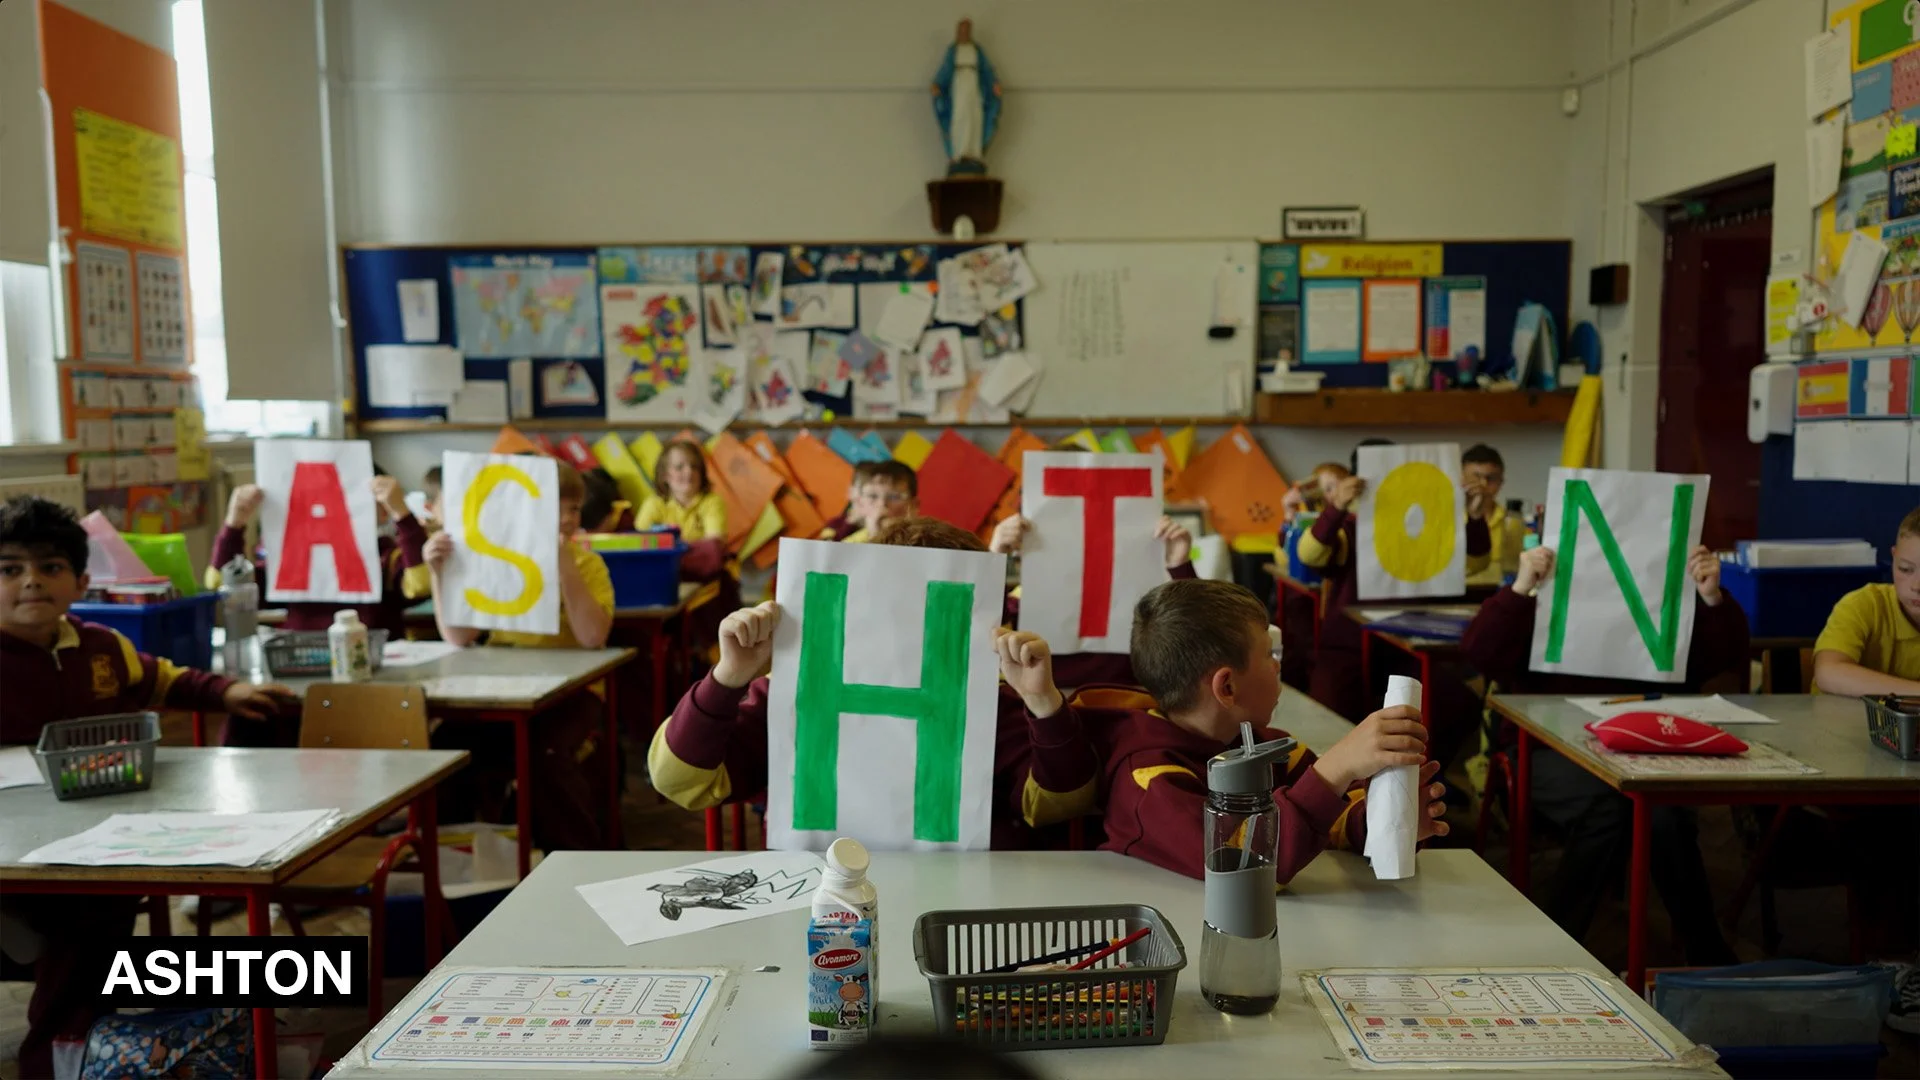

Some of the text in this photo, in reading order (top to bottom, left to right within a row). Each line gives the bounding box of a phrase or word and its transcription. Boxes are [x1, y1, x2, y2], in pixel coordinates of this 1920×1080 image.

[1341, 255, 1413, 277] Religion
[276, 464, 371, 593] A
[463, 464, 545, 617] S
[1044, 467, 1153, 639] T
[1373, 461, 1457, 584] O
[1545, 480, 1695, 673] N
[792, 571, 975, 843] H
